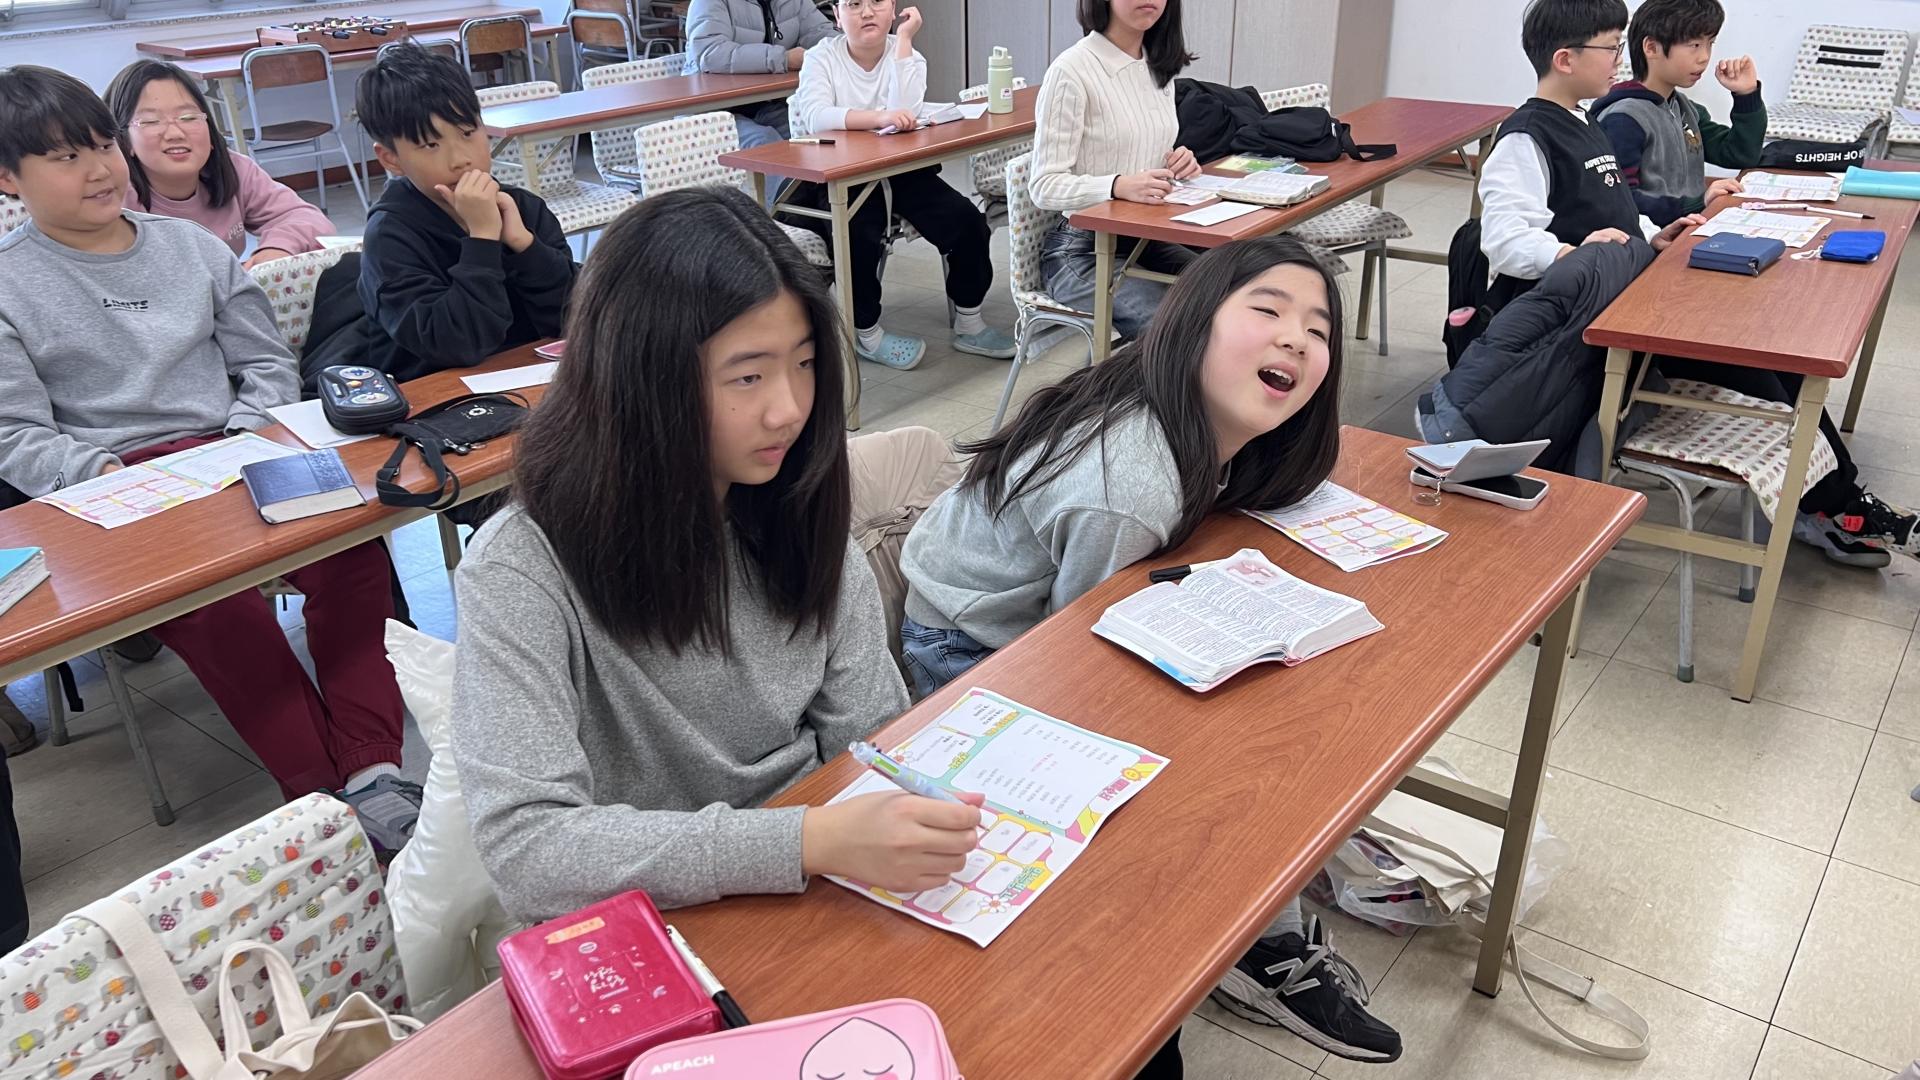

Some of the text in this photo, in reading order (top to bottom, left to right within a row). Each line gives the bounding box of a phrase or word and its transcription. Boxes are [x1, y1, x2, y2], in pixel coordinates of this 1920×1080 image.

[1795, 152, 1842, 163] HEIGHTS
[1843, 150, 1858, 160] OF
[650, 1054, 715, 1075] APEACH
